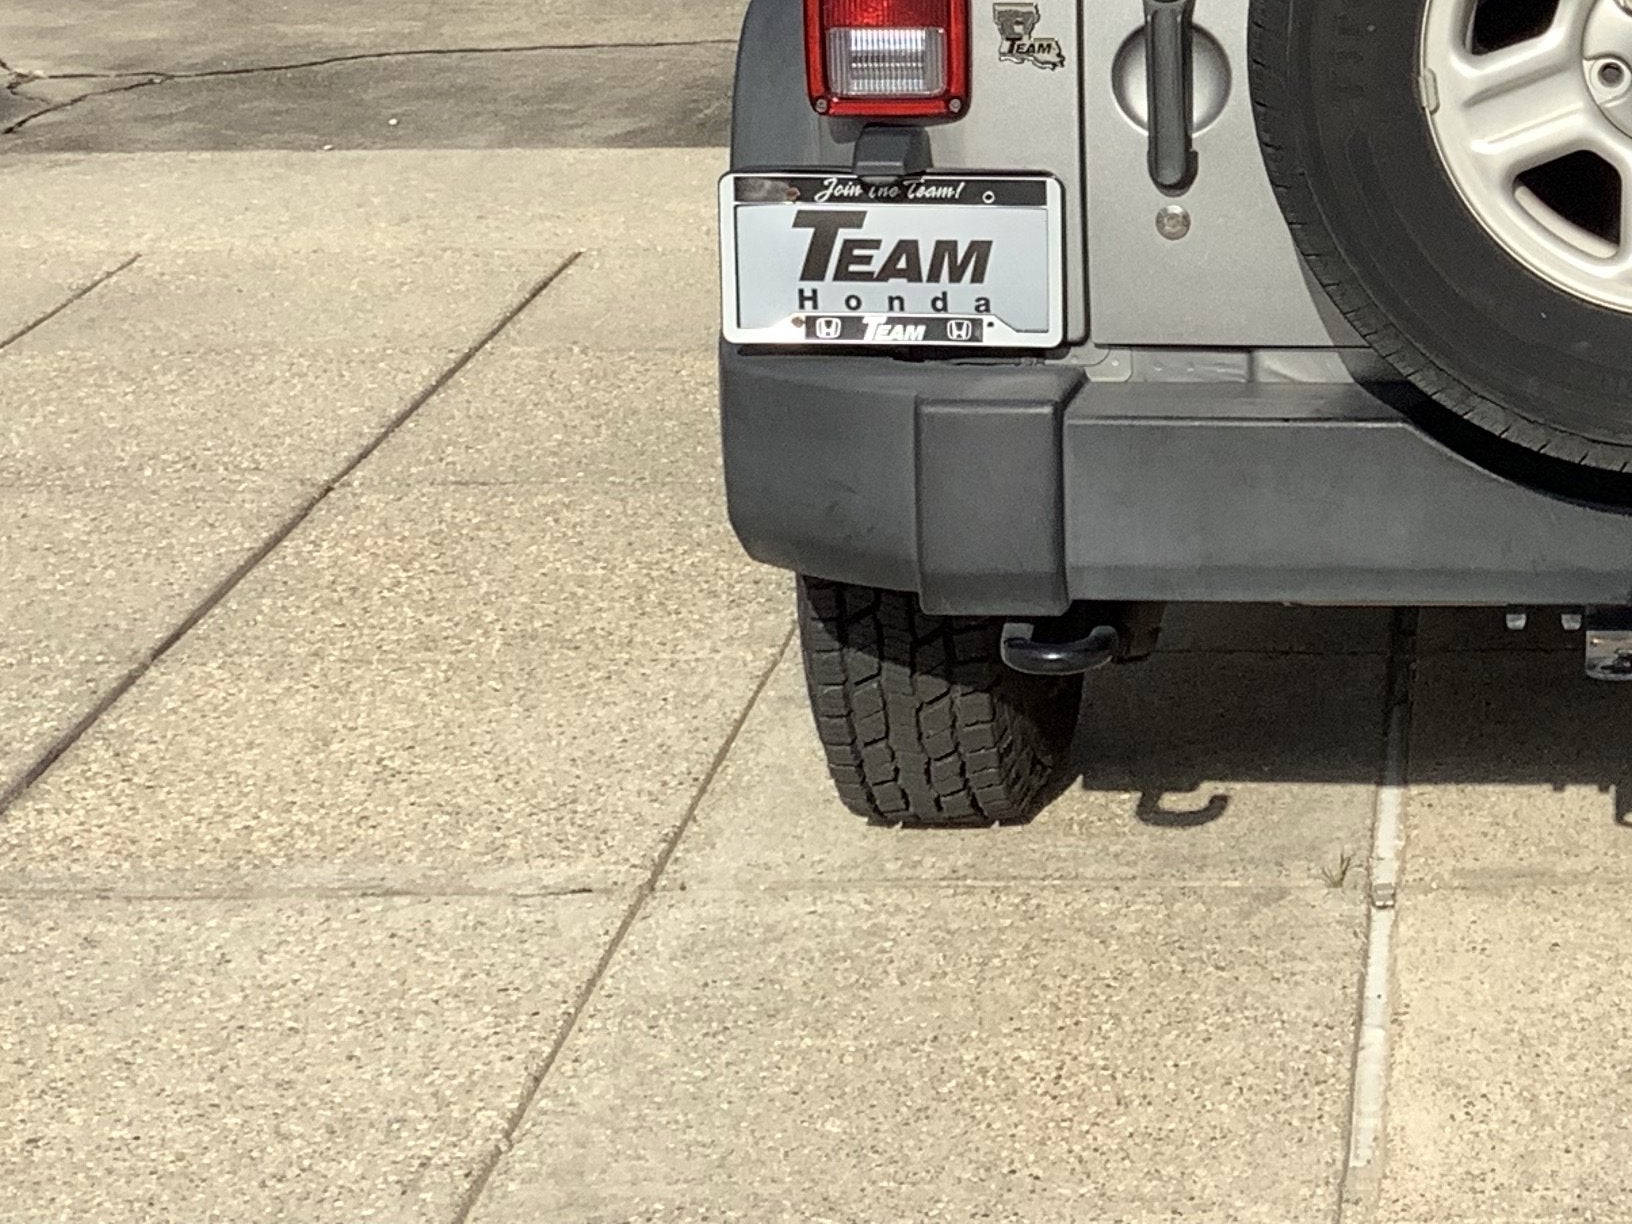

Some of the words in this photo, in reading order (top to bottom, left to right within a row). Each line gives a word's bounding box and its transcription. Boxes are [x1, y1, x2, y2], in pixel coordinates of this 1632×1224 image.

[814, 177, 863, 203] Join
[903, 178, 966, 199] Team!
[798, 288, 991, 313] Honda
